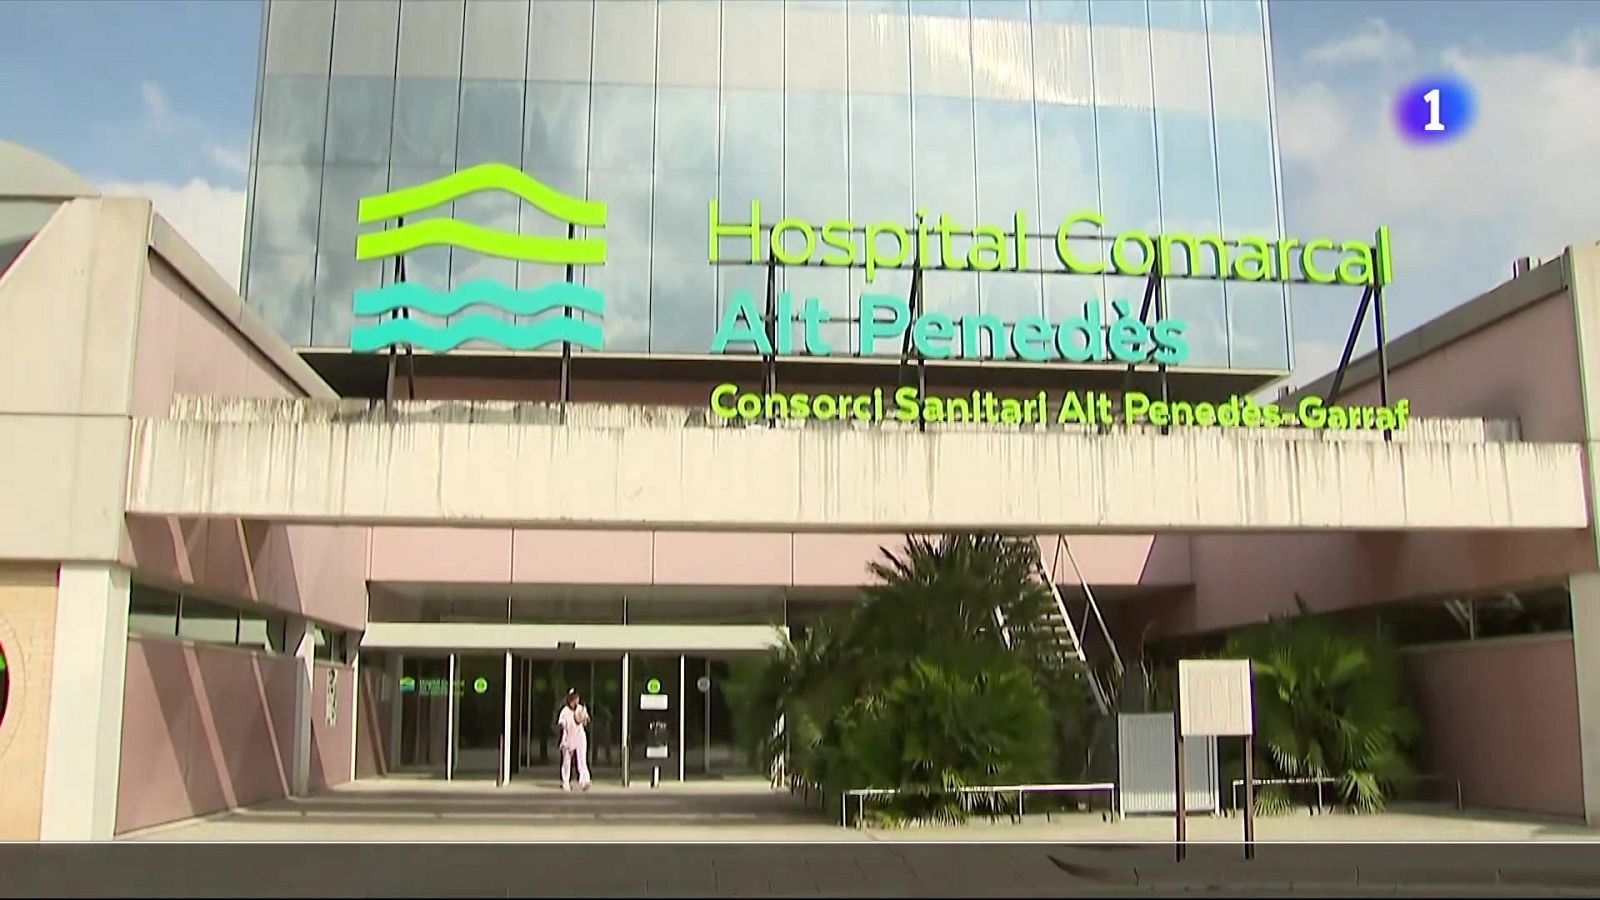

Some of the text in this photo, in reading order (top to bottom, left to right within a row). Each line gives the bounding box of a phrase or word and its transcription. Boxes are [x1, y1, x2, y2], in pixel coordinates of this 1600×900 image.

[708, 199, 1393, 287] Hospital Comarcal
[710, 289, 1190, 365] Alt Penedès
[710, 383, 1410, 431] Consorci Sanitari Alt Penedès-Garraf
